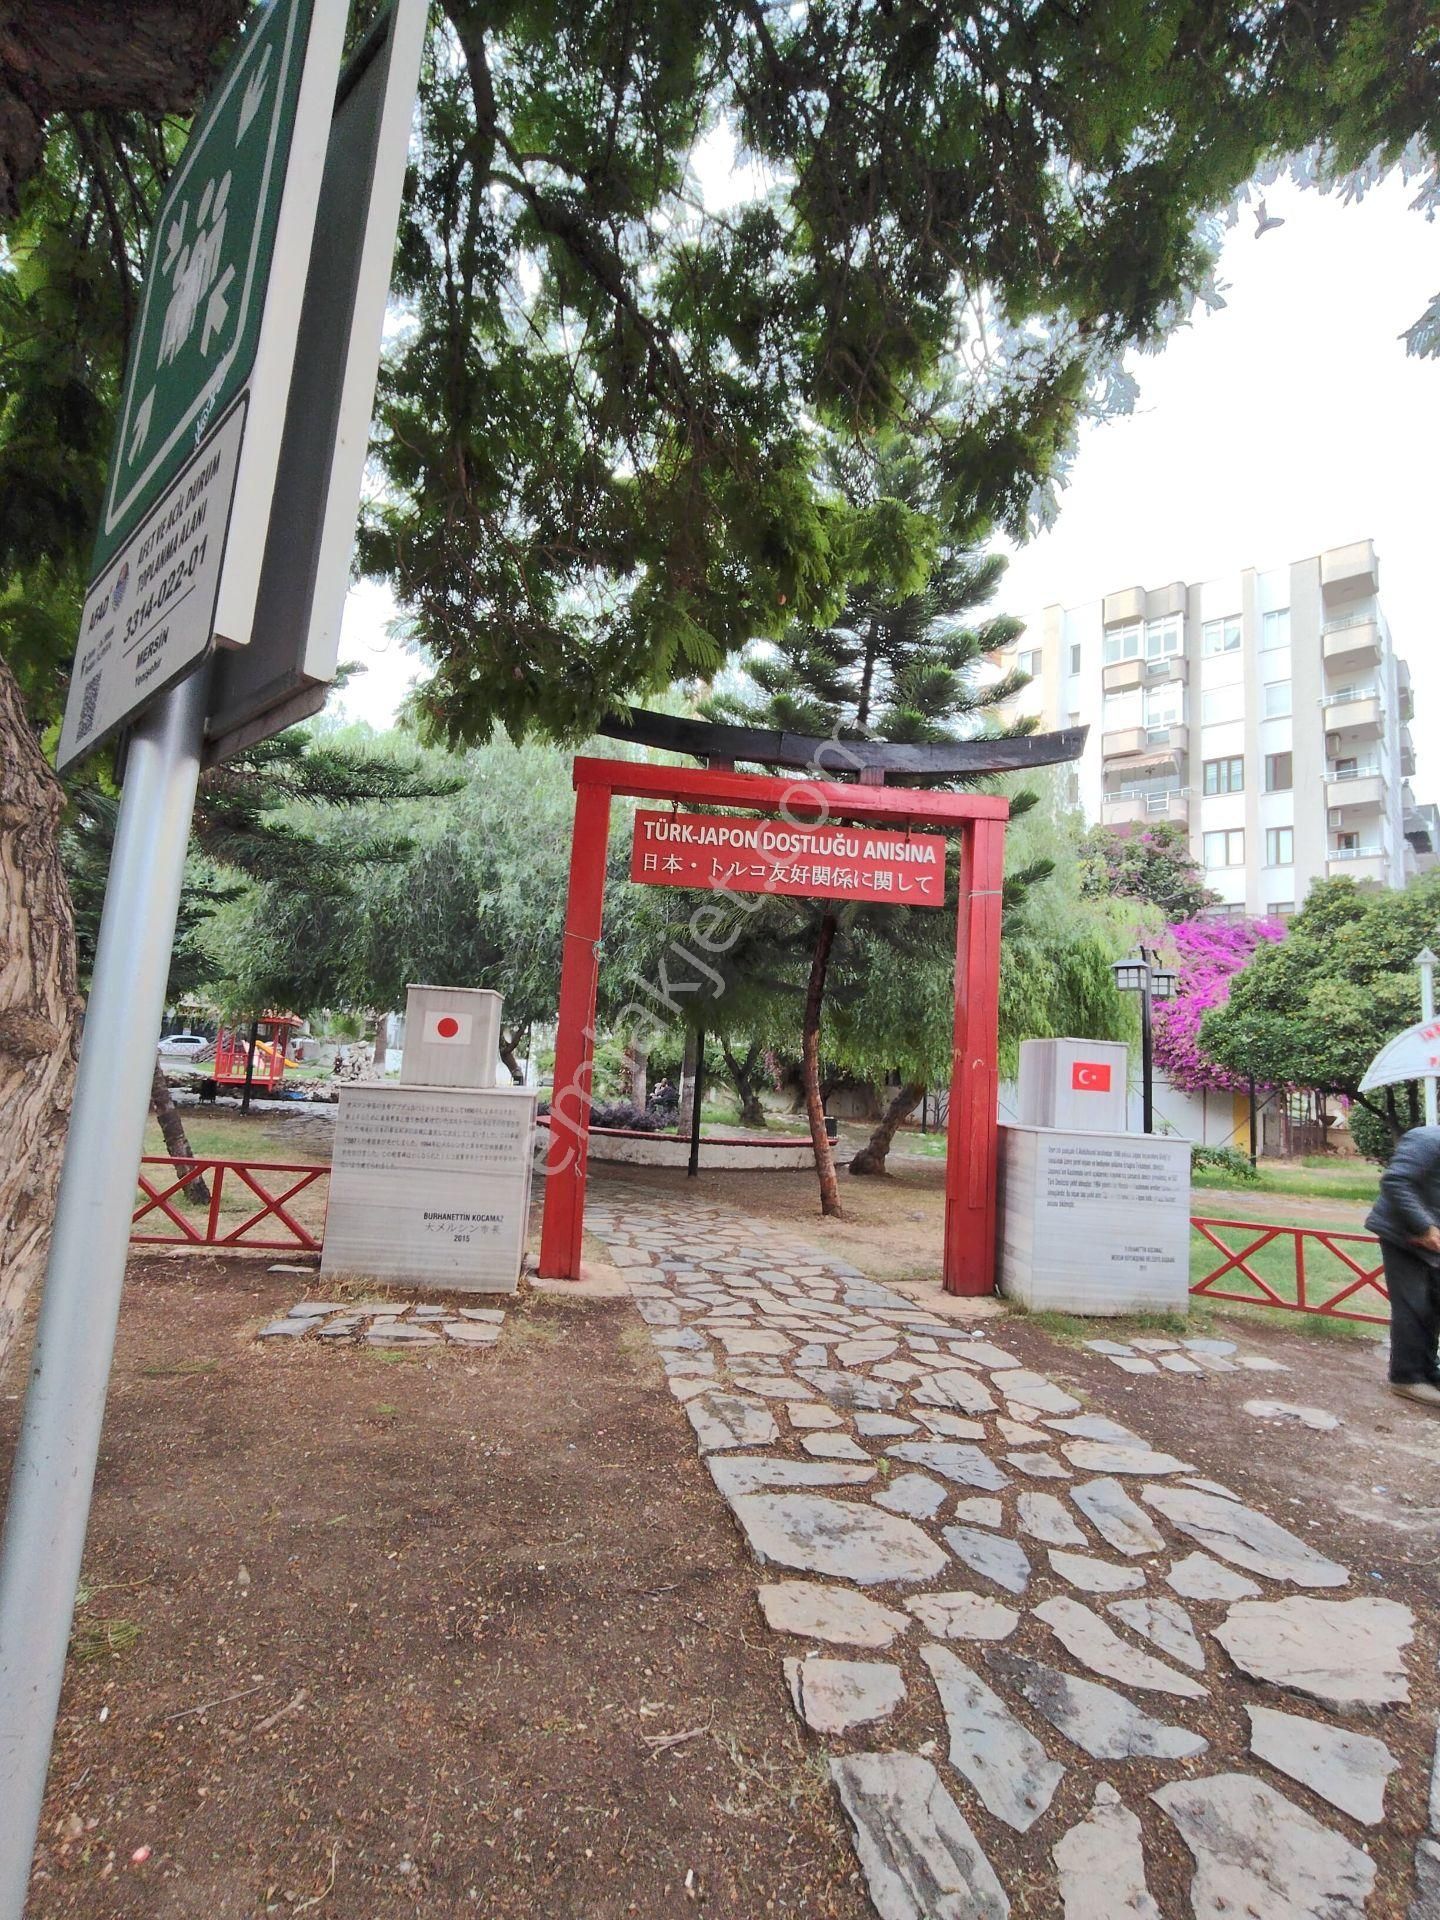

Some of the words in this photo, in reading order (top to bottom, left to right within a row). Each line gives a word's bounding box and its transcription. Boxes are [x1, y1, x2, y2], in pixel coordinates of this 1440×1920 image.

[156, 517, 167, 545] VE
[185, 448, 221, 511] DURUM
[136, 532, 179, 596] TOPLANMA
[178, 497, 208, 548] ALANI
[123, 534, 208, 644] 3314-022-01
[136, 626, 169, 670] MERSİN
[643, 817, 759, 849] TÜRK-JAPON
[762, 831, 859, 858] DOSTLUĞU
[863, 841, 937, 865] ANISINA
[453, 1234, 471, 1243] 2015
